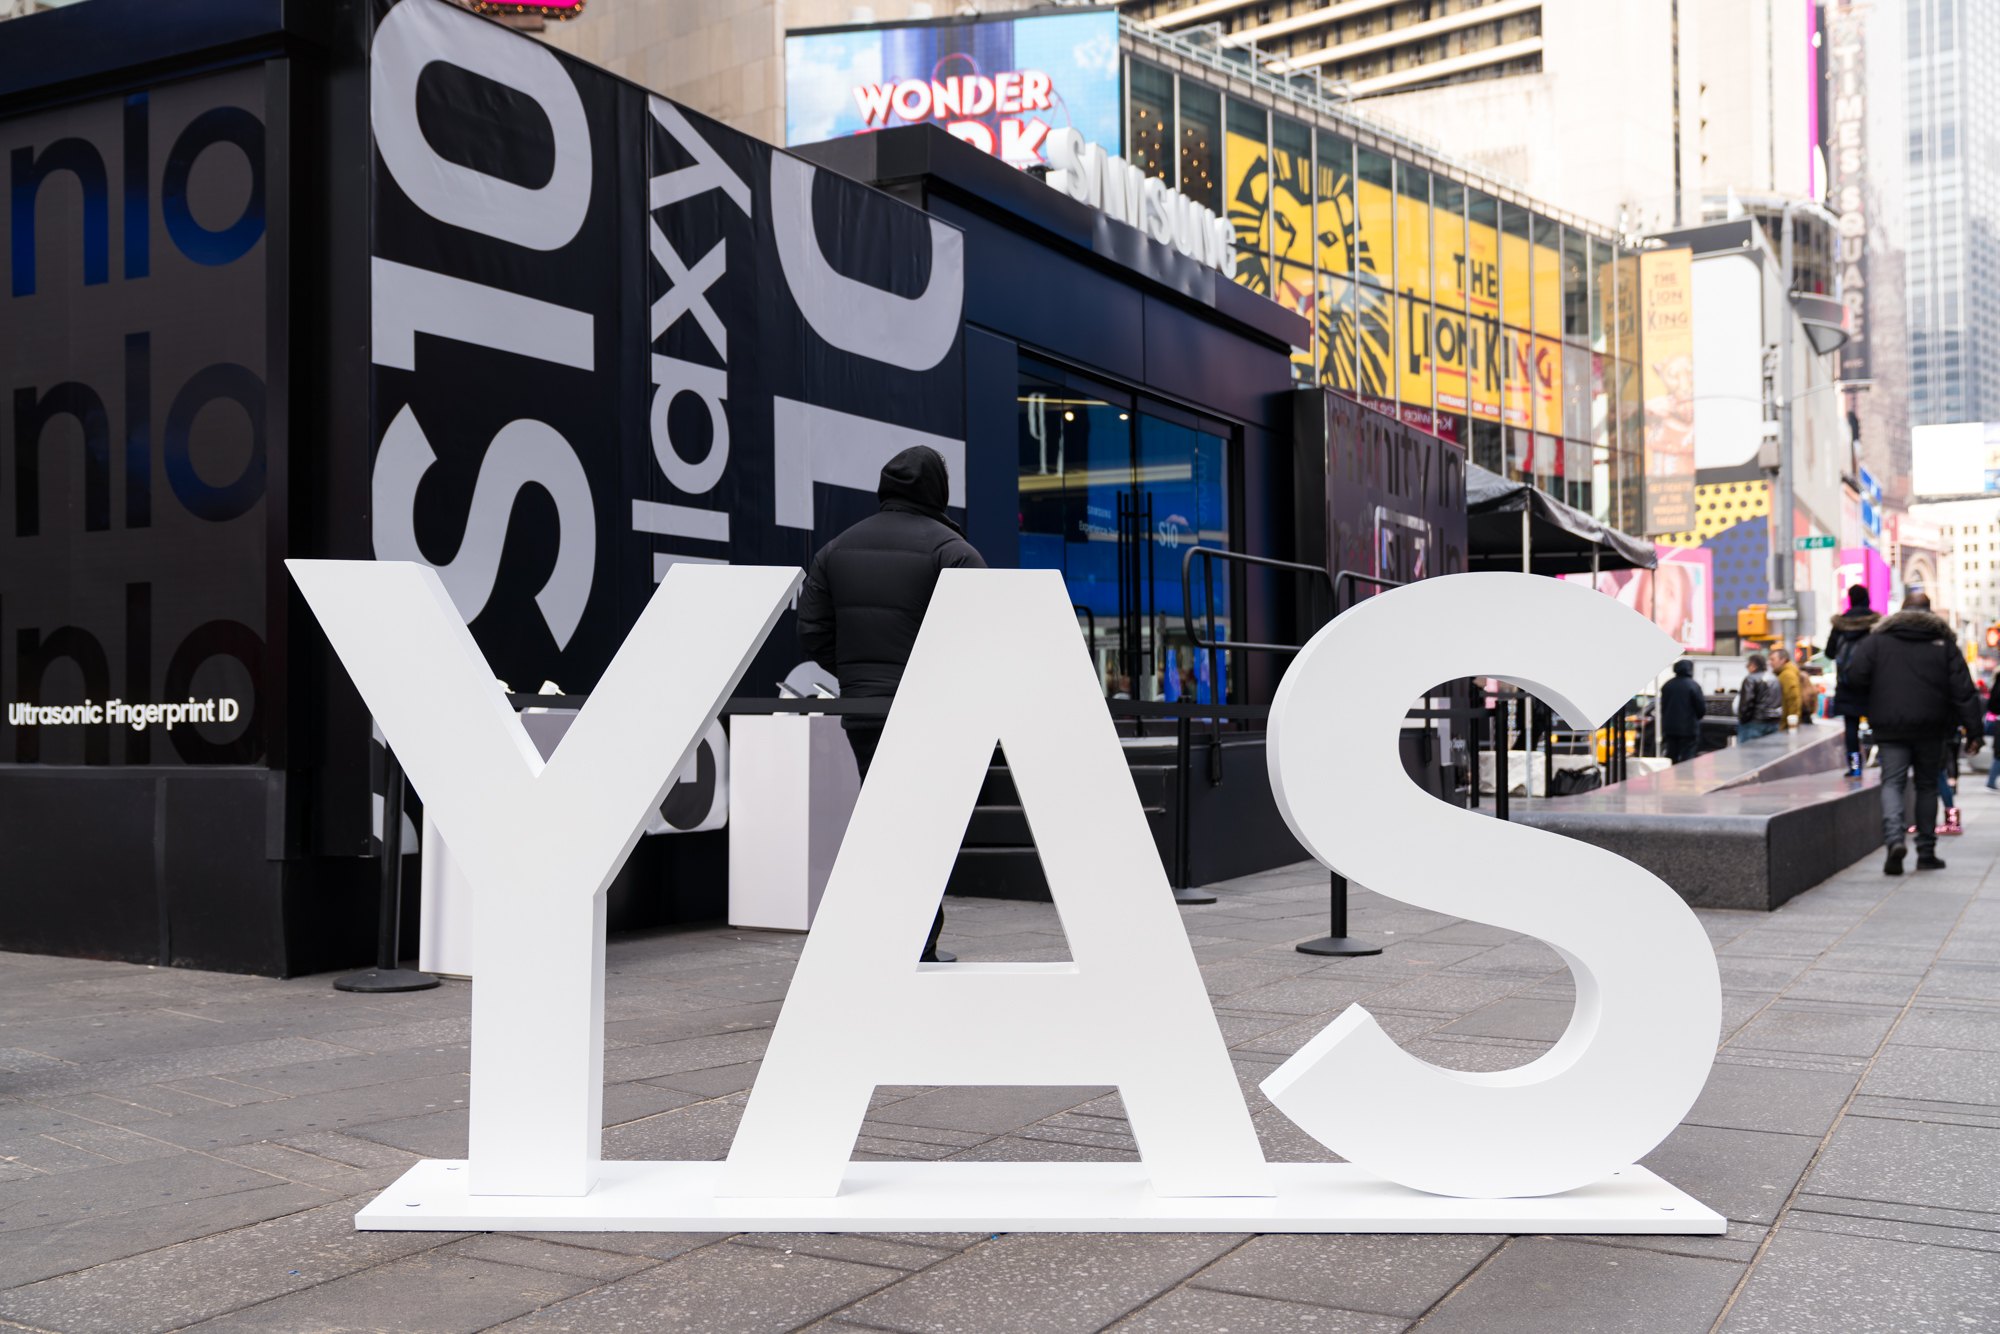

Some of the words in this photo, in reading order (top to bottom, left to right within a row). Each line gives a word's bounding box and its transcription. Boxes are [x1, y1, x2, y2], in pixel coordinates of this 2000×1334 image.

[852, 69, 1053, 127] WONDER
[1833, 44, 1863, 174] TIMES
[1045, 126, 1237, 280] SAMSUNG
[1453, 253, 1498, 299] THE
[371, 0, 597, 653] S10
[1407, 288, 1478, 376] LION
[1483, 312, 1553, 392] KING
[1647, 308, 1689, 333] KING
[1159, 521, 1179, 549] S10
[8, 698, 103, 726] Ultrasonic
[105, 696, 216, 732] Fingerprint
[218, 697, 239, 723] ID
[285, 558, 1723, 1199] YAS
